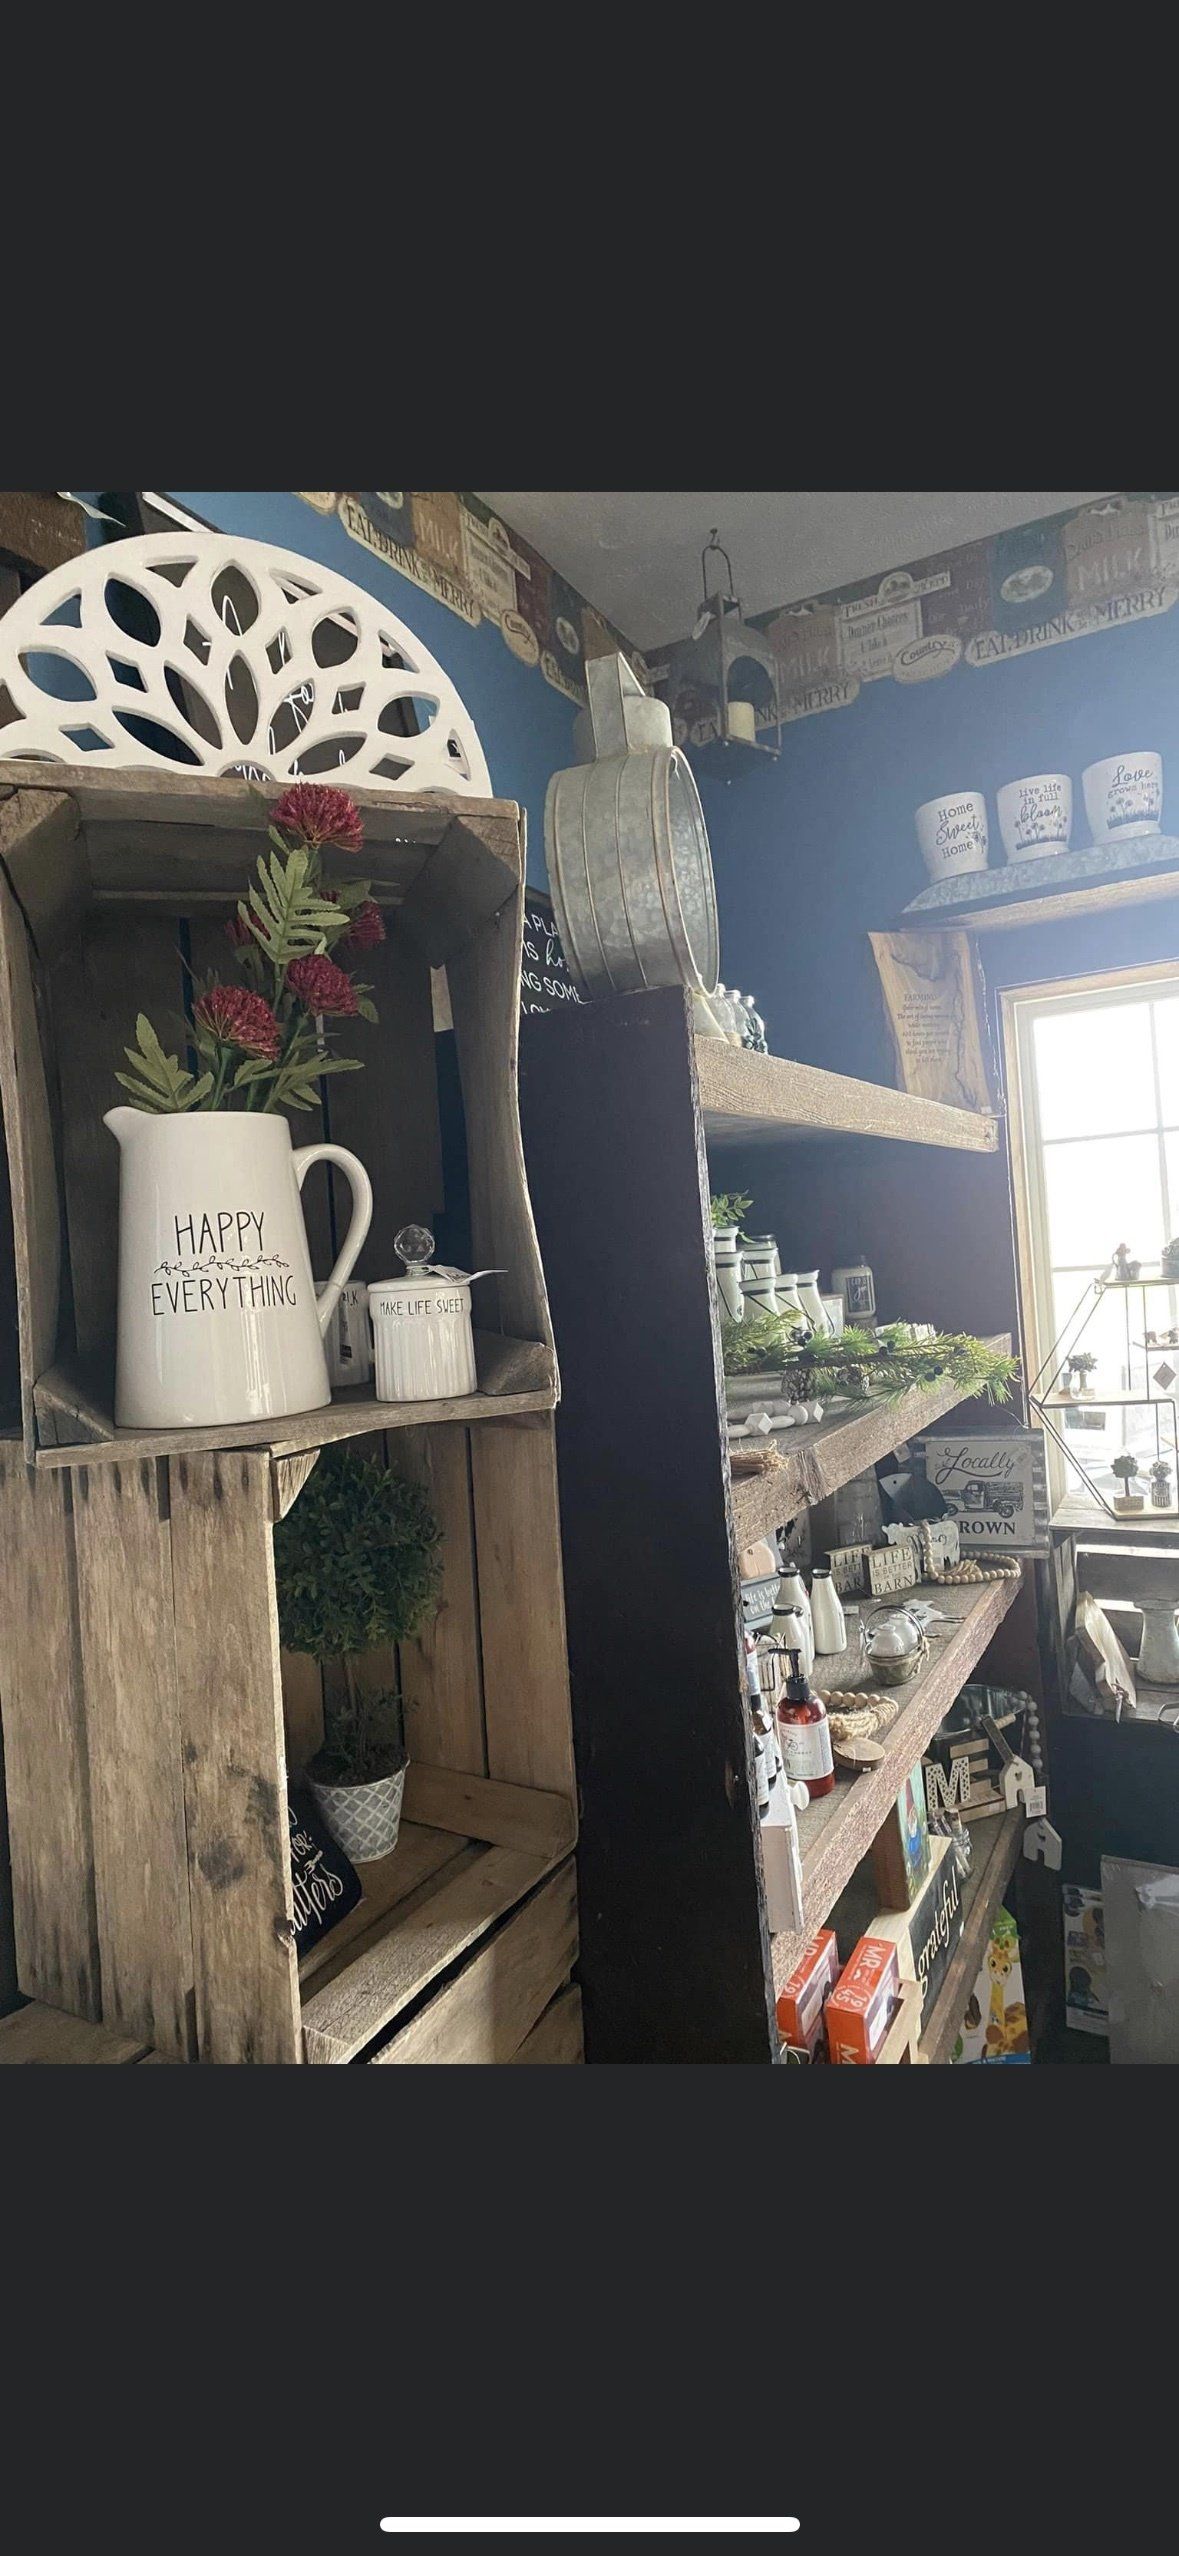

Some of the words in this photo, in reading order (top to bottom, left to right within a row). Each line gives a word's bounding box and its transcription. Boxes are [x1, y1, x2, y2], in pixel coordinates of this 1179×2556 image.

[1014, 617, 1075, 648] DRINK
[1097, 586, 1167, 622] MERRY
[1112, 765, 1153, 787] Love
[1019, 786, 1040, 798] live
[1044, 783, 1061, 794] life
[1023, 795, 1035, 805] in
[1038, 792, 1058, 803] full
[938, 802, 974, 822] Home
[1020, 803, 1062, 824] bloom
[936, 815, 979, 845] Sweet
[942, 840, 974, 859] Home
[531, 914, 560, 938] PLA
[174, 1211, 264, 1256] HAPPY
[151, 1275, 297, 1316] EVERYTHING
[379, 1300, 403, 1316] MAKE
[408, 1300, 432, 1315] LIFE
[437, 1298, 464, 1314] SWEET
[935, 1447, 1015, 1485] Locally
[959, 1520, 1016, 1535] ROWN
[872, 1547, 912, 1568] LIFE
[872, 1569, 880, 1577] IS
[882, 1561, 912, 1574] BETTER
[874, 1575, 914, 1594] BARN
[916, 1866, 960, 1998] grateful
